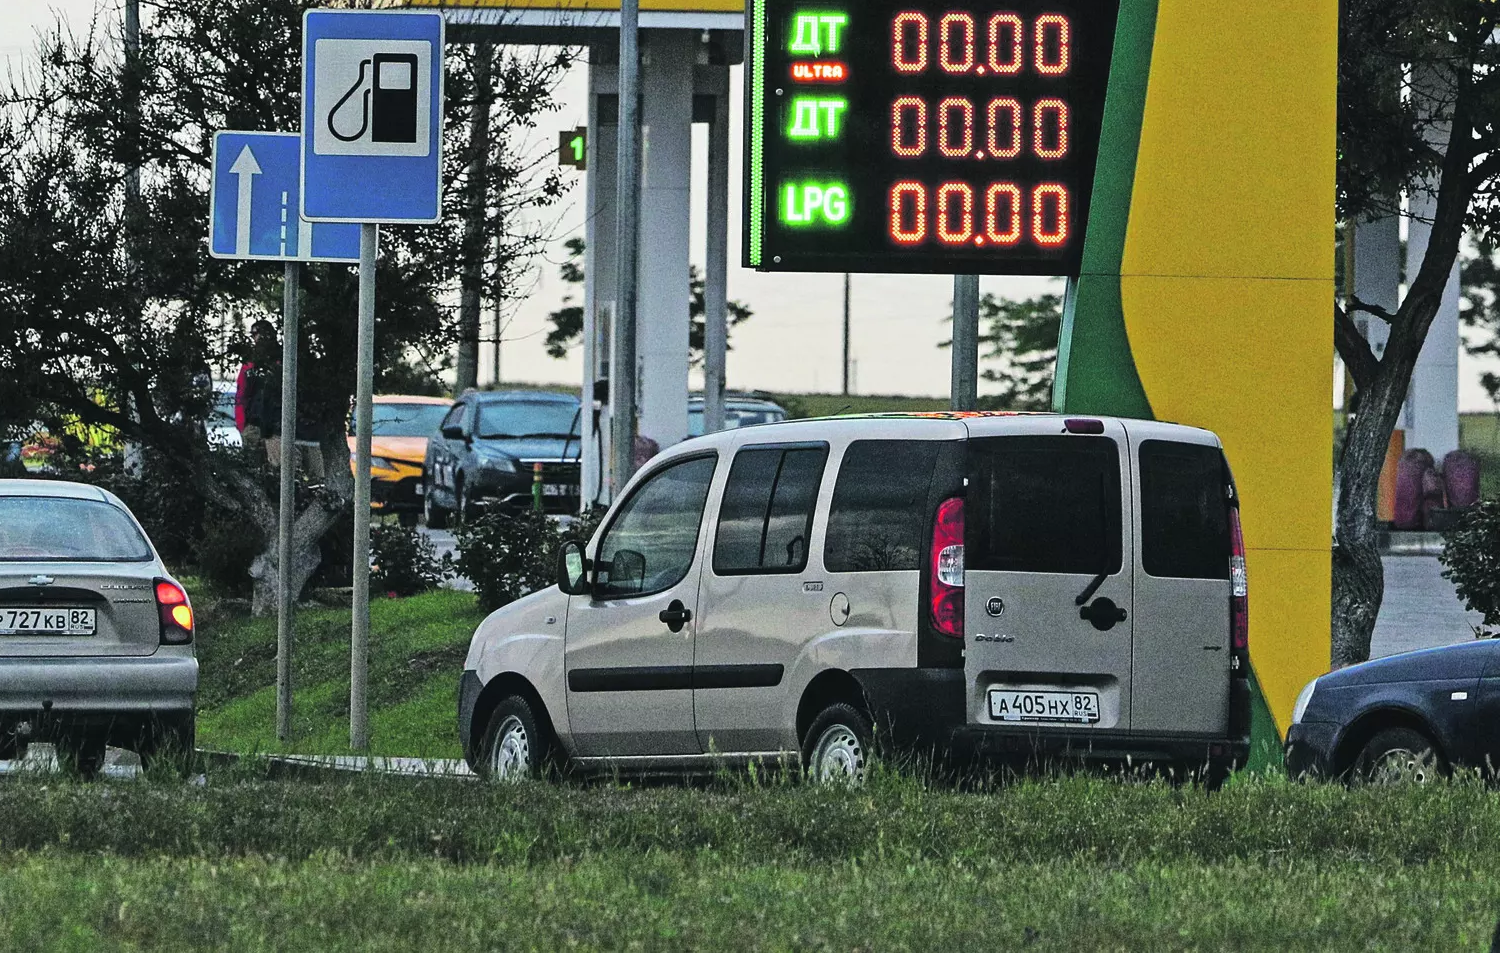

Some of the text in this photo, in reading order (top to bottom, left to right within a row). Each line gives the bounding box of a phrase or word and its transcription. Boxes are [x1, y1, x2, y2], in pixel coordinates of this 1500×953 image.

[791, 12, 1069, 75] ДТ 00.00
[793, 65, 843, 78] ULTRA
[790, 96, 1069, 160] ДТ 00.00
[786, 180, 1069, 247] LPG 00.00
